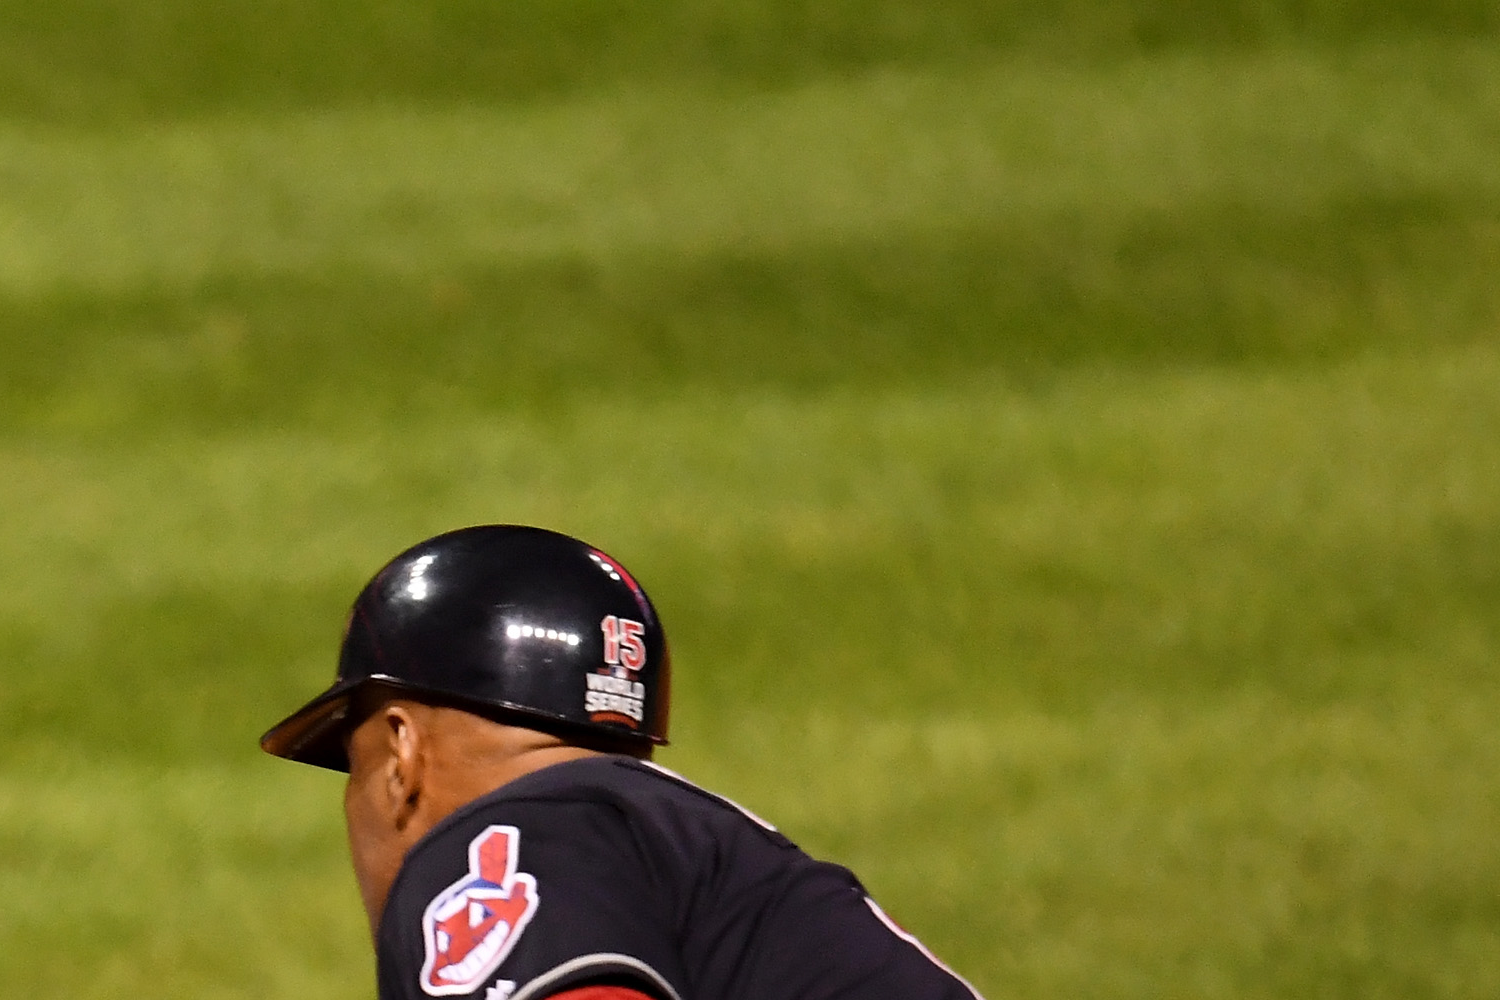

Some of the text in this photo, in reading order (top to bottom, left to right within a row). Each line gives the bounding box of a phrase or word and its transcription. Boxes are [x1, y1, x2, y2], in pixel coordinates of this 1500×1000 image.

[601, 615, 646, 671] 15
[585, 672, 645, 700] WORLD
[584, 690, 644, 721] SERIES
